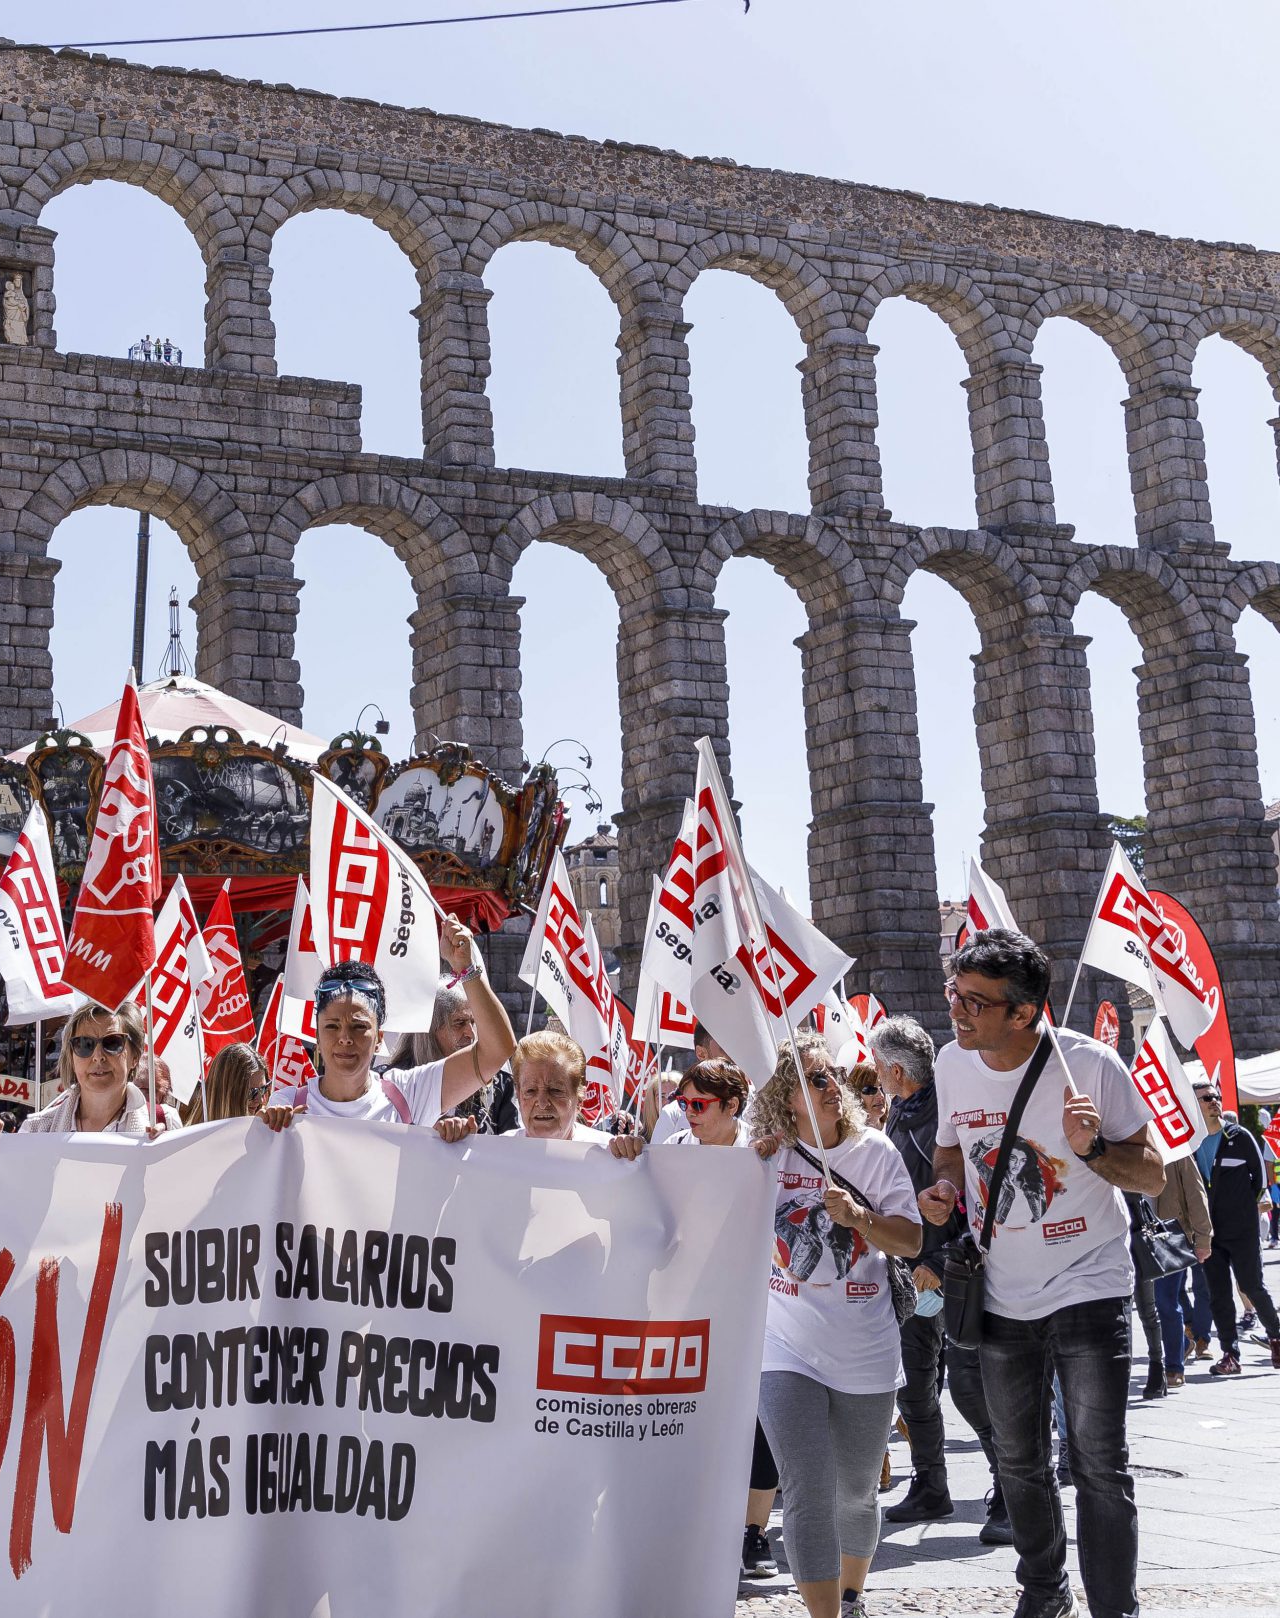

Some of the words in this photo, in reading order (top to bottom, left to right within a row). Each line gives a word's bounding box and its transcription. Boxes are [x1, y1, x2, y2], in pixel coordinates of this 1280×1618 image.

[390, 865, 415, 958] Segovi
[1045, 1220, 1084, 1236] CCOO
[144, 1224, 261, 1308] SUBIR
[274, 1221, 457, 1314] SALARIOS
[144, 1325, 330, 1413] CONTENER
[335, 1330, 500, 1423] PRECIOS
[552, 1330, 703, 1381] CCOO
[534, 1415, 561, 1434] de
[566, 1417, 636, 1438] Castilla
[638, 1424, 649, 1442] y
[651, 1418, 685, 1437] León
[535, 1395, 643, 1418] comisiones
[646, 1398, 697, 1416] obreras
[144, 1417, 231, 1522] MÁS
[245, 1432, 417, 1522] IGUALDAD
